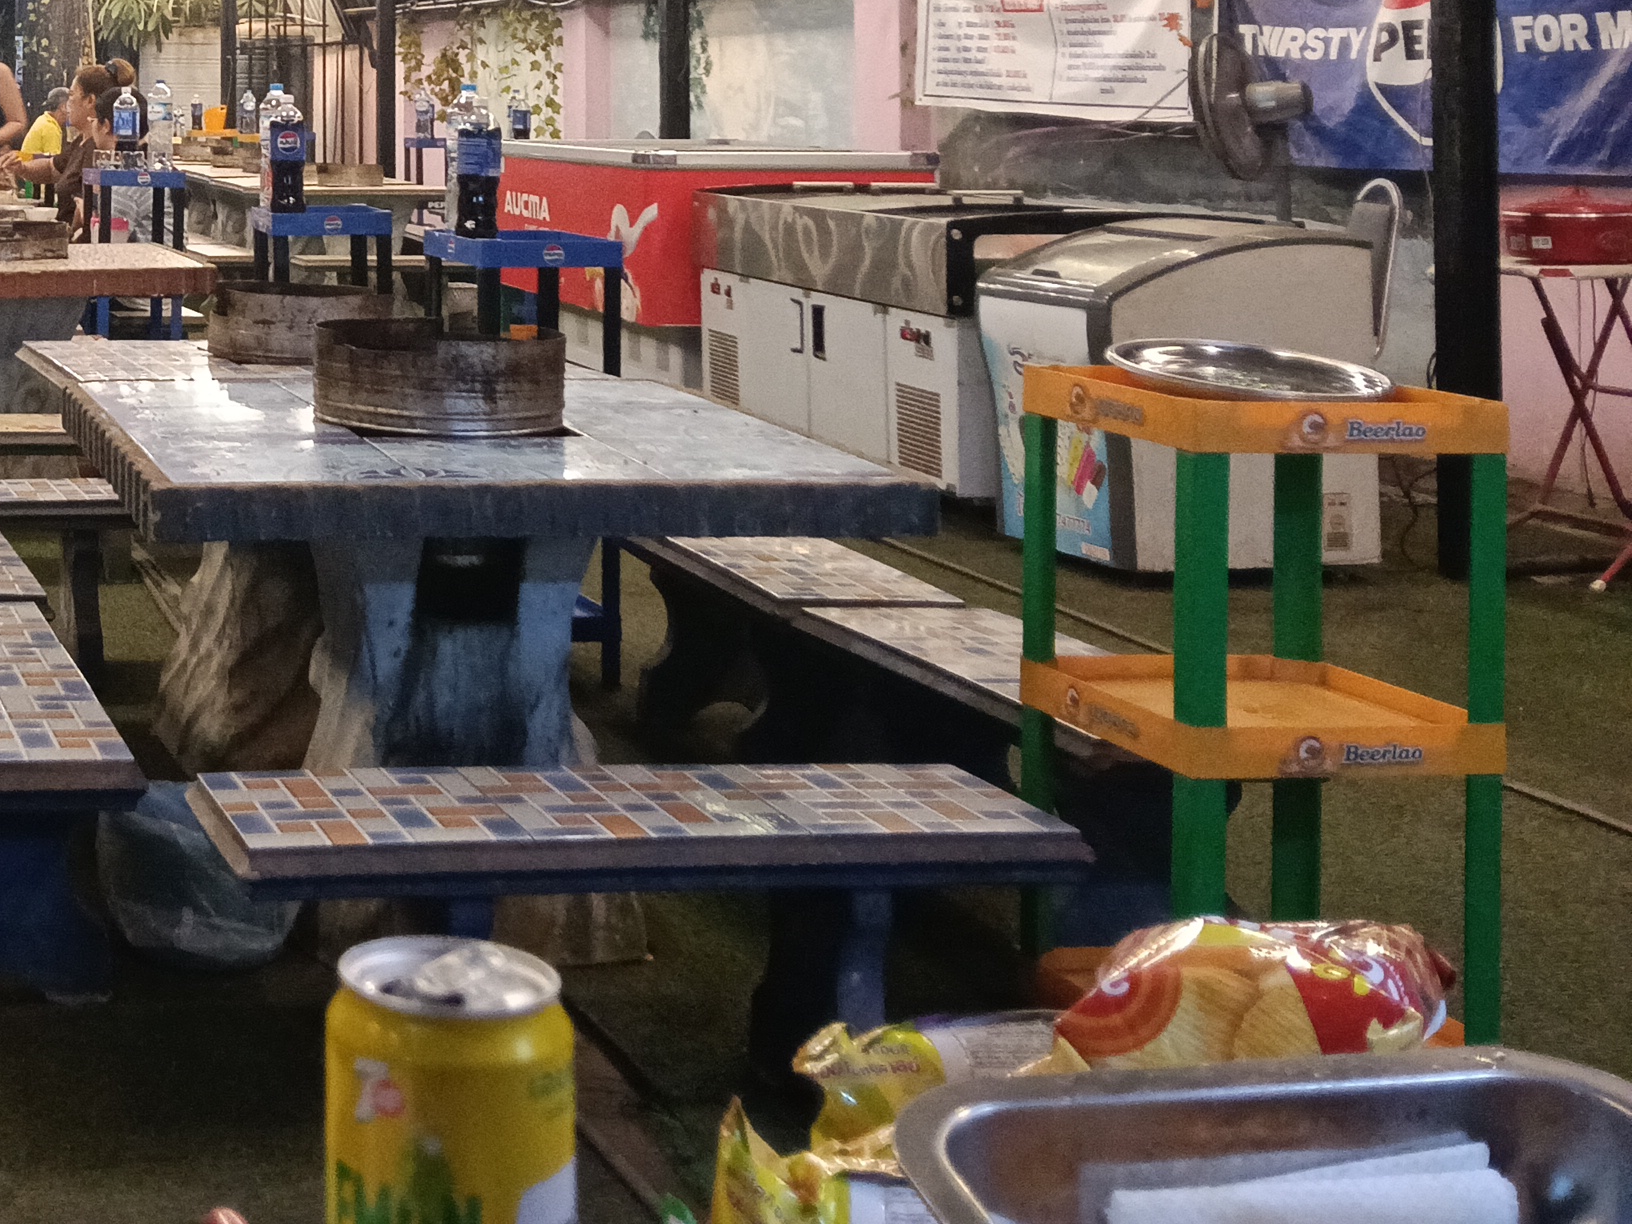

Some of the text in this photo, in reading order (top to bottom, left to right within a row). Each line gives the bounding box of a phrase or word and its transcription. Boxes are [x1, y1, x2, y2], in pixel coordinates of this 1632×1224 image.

[1373, 19, 1432, 63] PE
[1511, 13, 1593, 53] FOR
[504, 190, 551, 222] AUCMA
[1346, 419, 1427, 441] Beerlao
[1343, 743, 1423, 763] Beerlao
